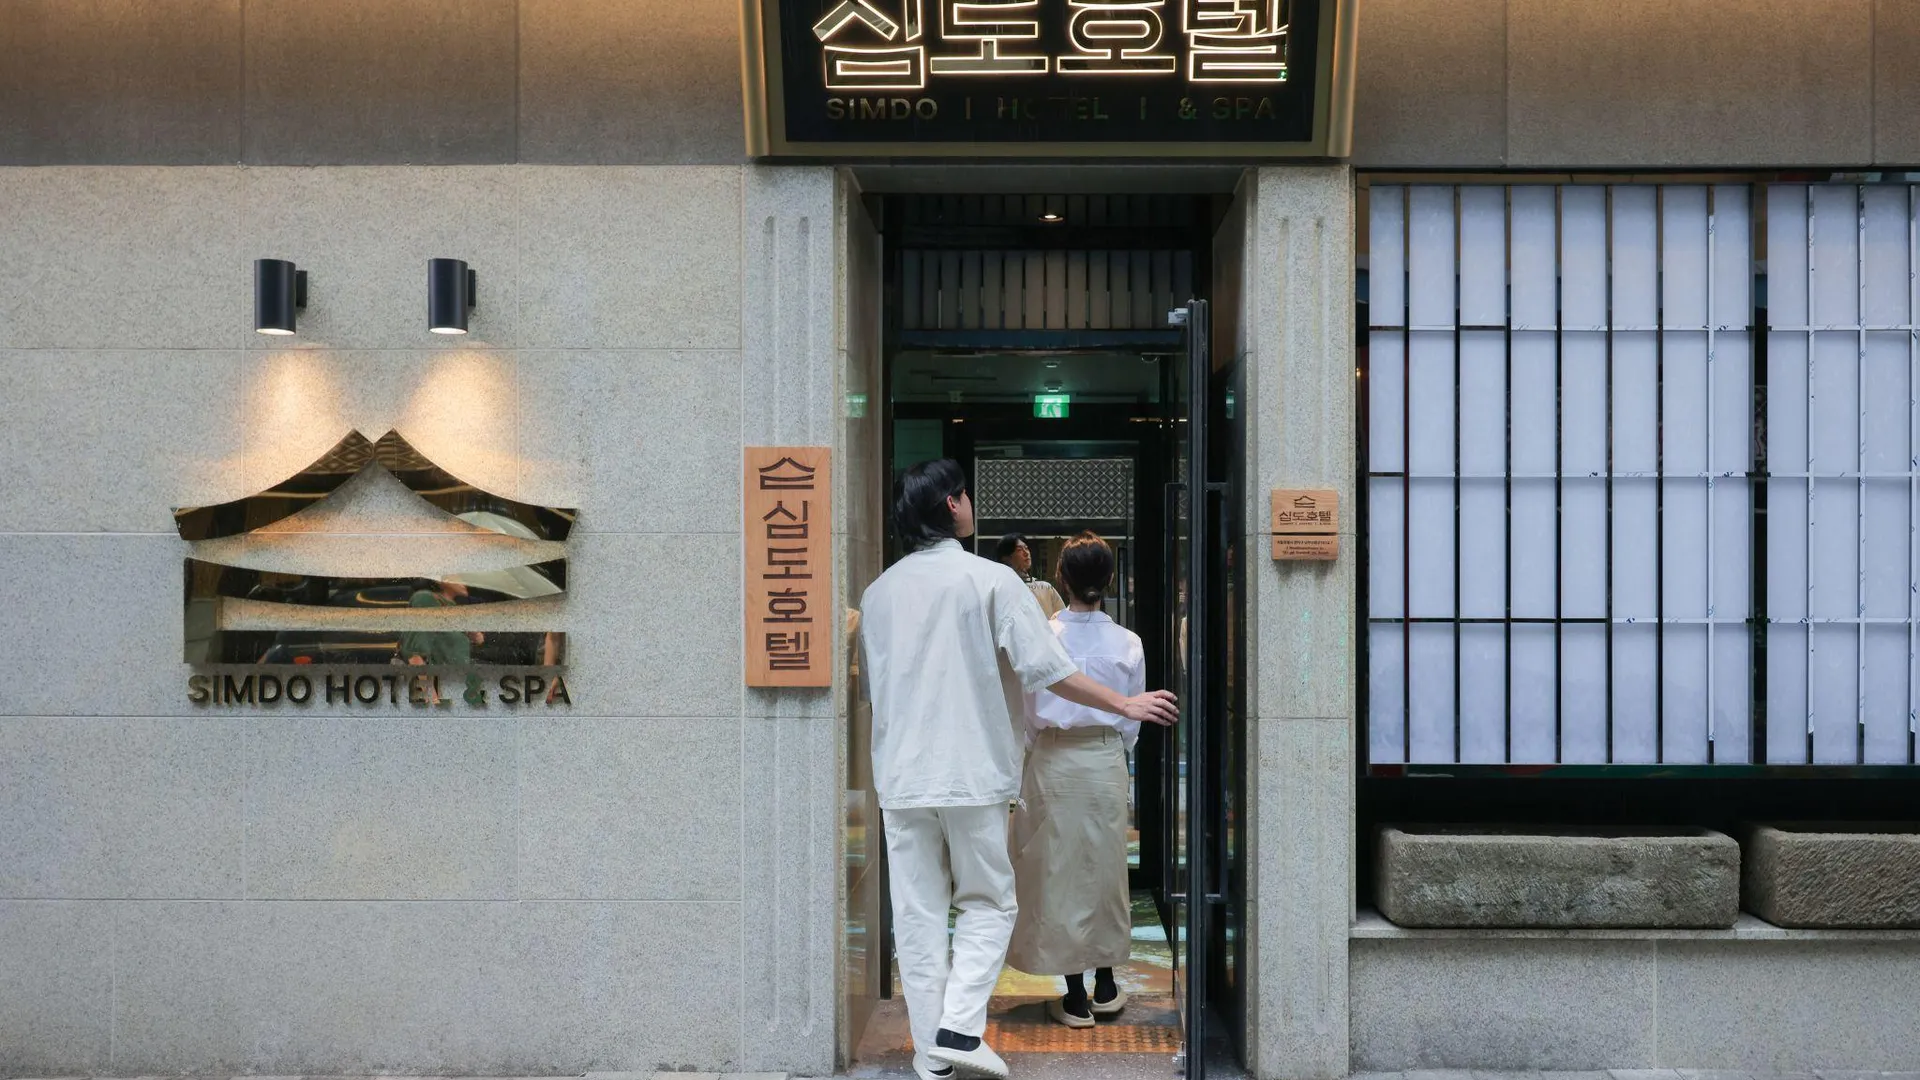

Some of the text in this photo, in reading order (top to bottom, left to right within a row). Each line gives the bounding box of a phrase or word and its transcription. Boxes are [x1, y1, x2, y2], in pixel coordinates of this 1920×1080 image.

[812, 0, 1289, 88] 심도호텔
[827, 97, 939, 120] SIMDO
[997, 97, 1109, 120] HOTEL
[1177, 97, 1197, 120] &
[1212, 97, 1276, 120] SPA
[1279, 511, 1331, 522] 심도호텔
[762, 500, 813, 671] 심도호텔
[187, 674, 572, 705] SIMDO HOTEL & SPA
